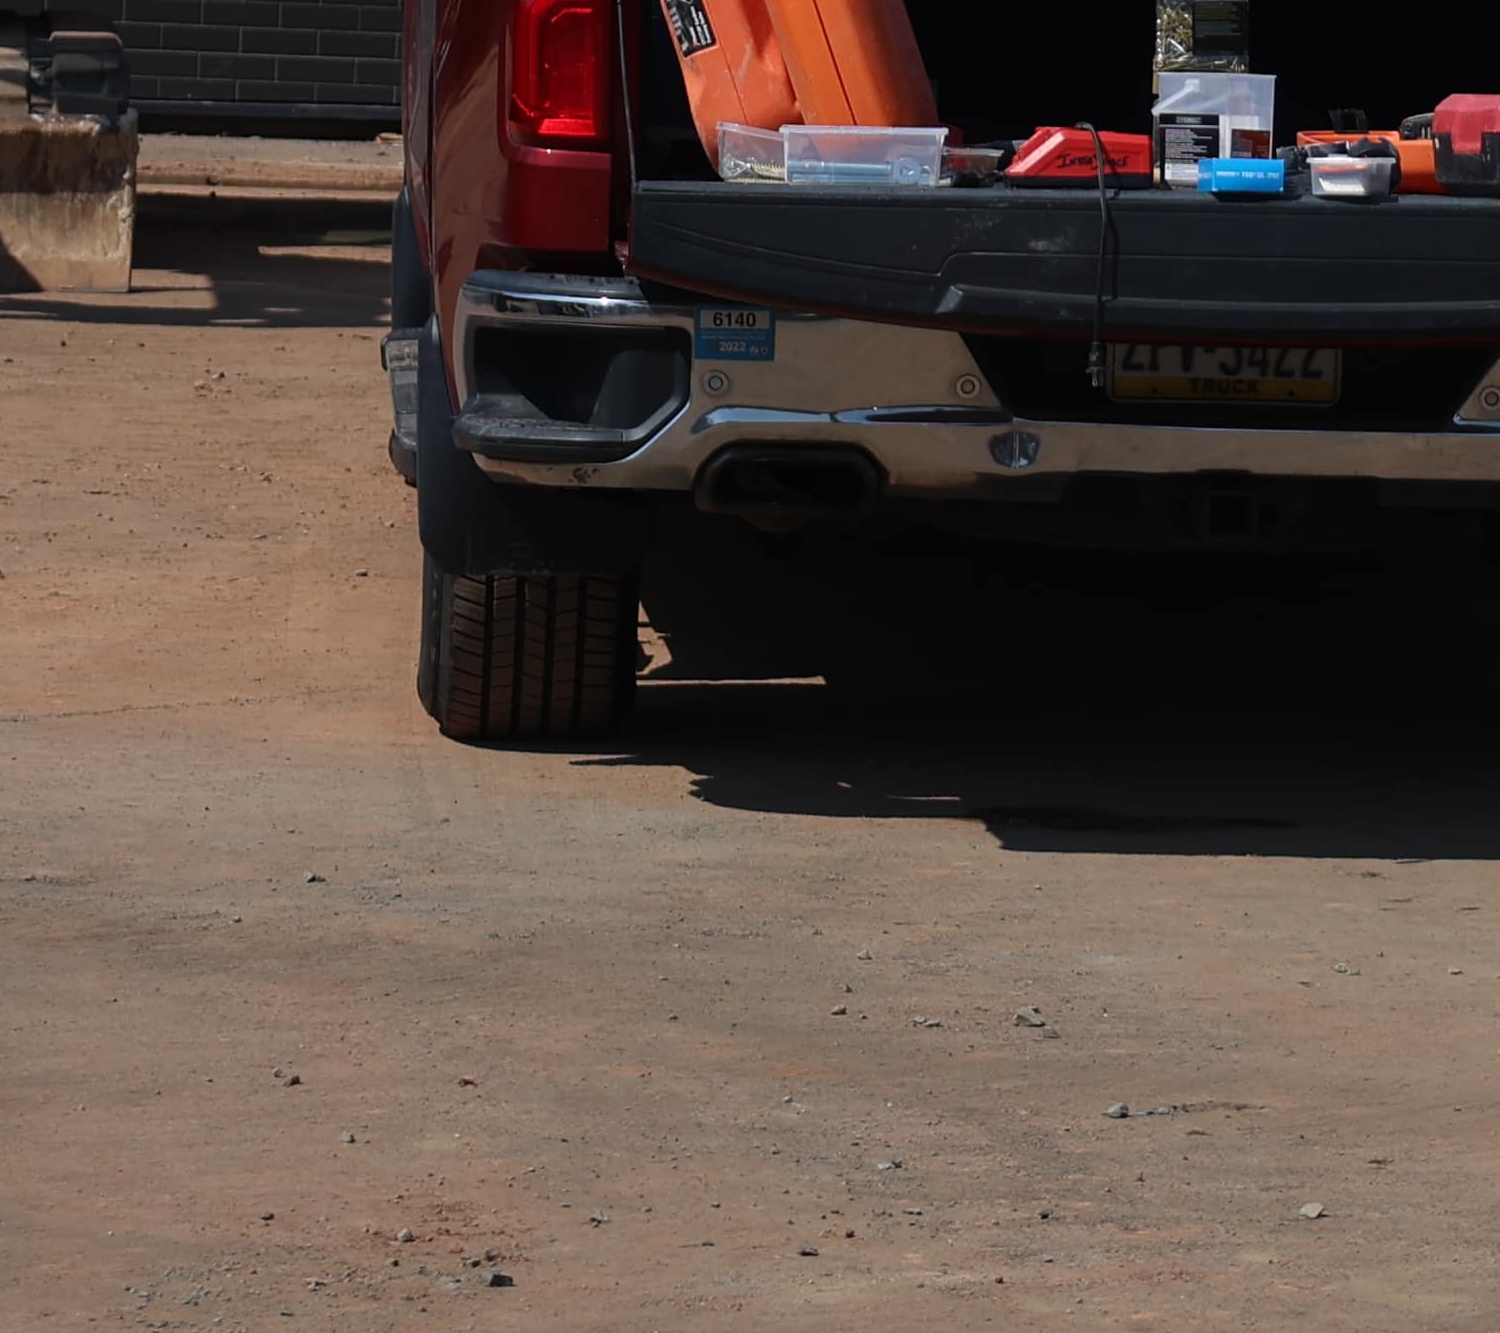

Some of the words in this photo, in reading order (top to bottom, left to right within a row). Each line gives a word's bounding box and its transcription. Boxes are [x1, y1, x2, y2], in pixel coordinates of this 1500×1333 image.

[713, 312, 757, 327] 6140
[718, 341, 747, 352] 2022
[1188, 377, 1262, 395] TRUCK
